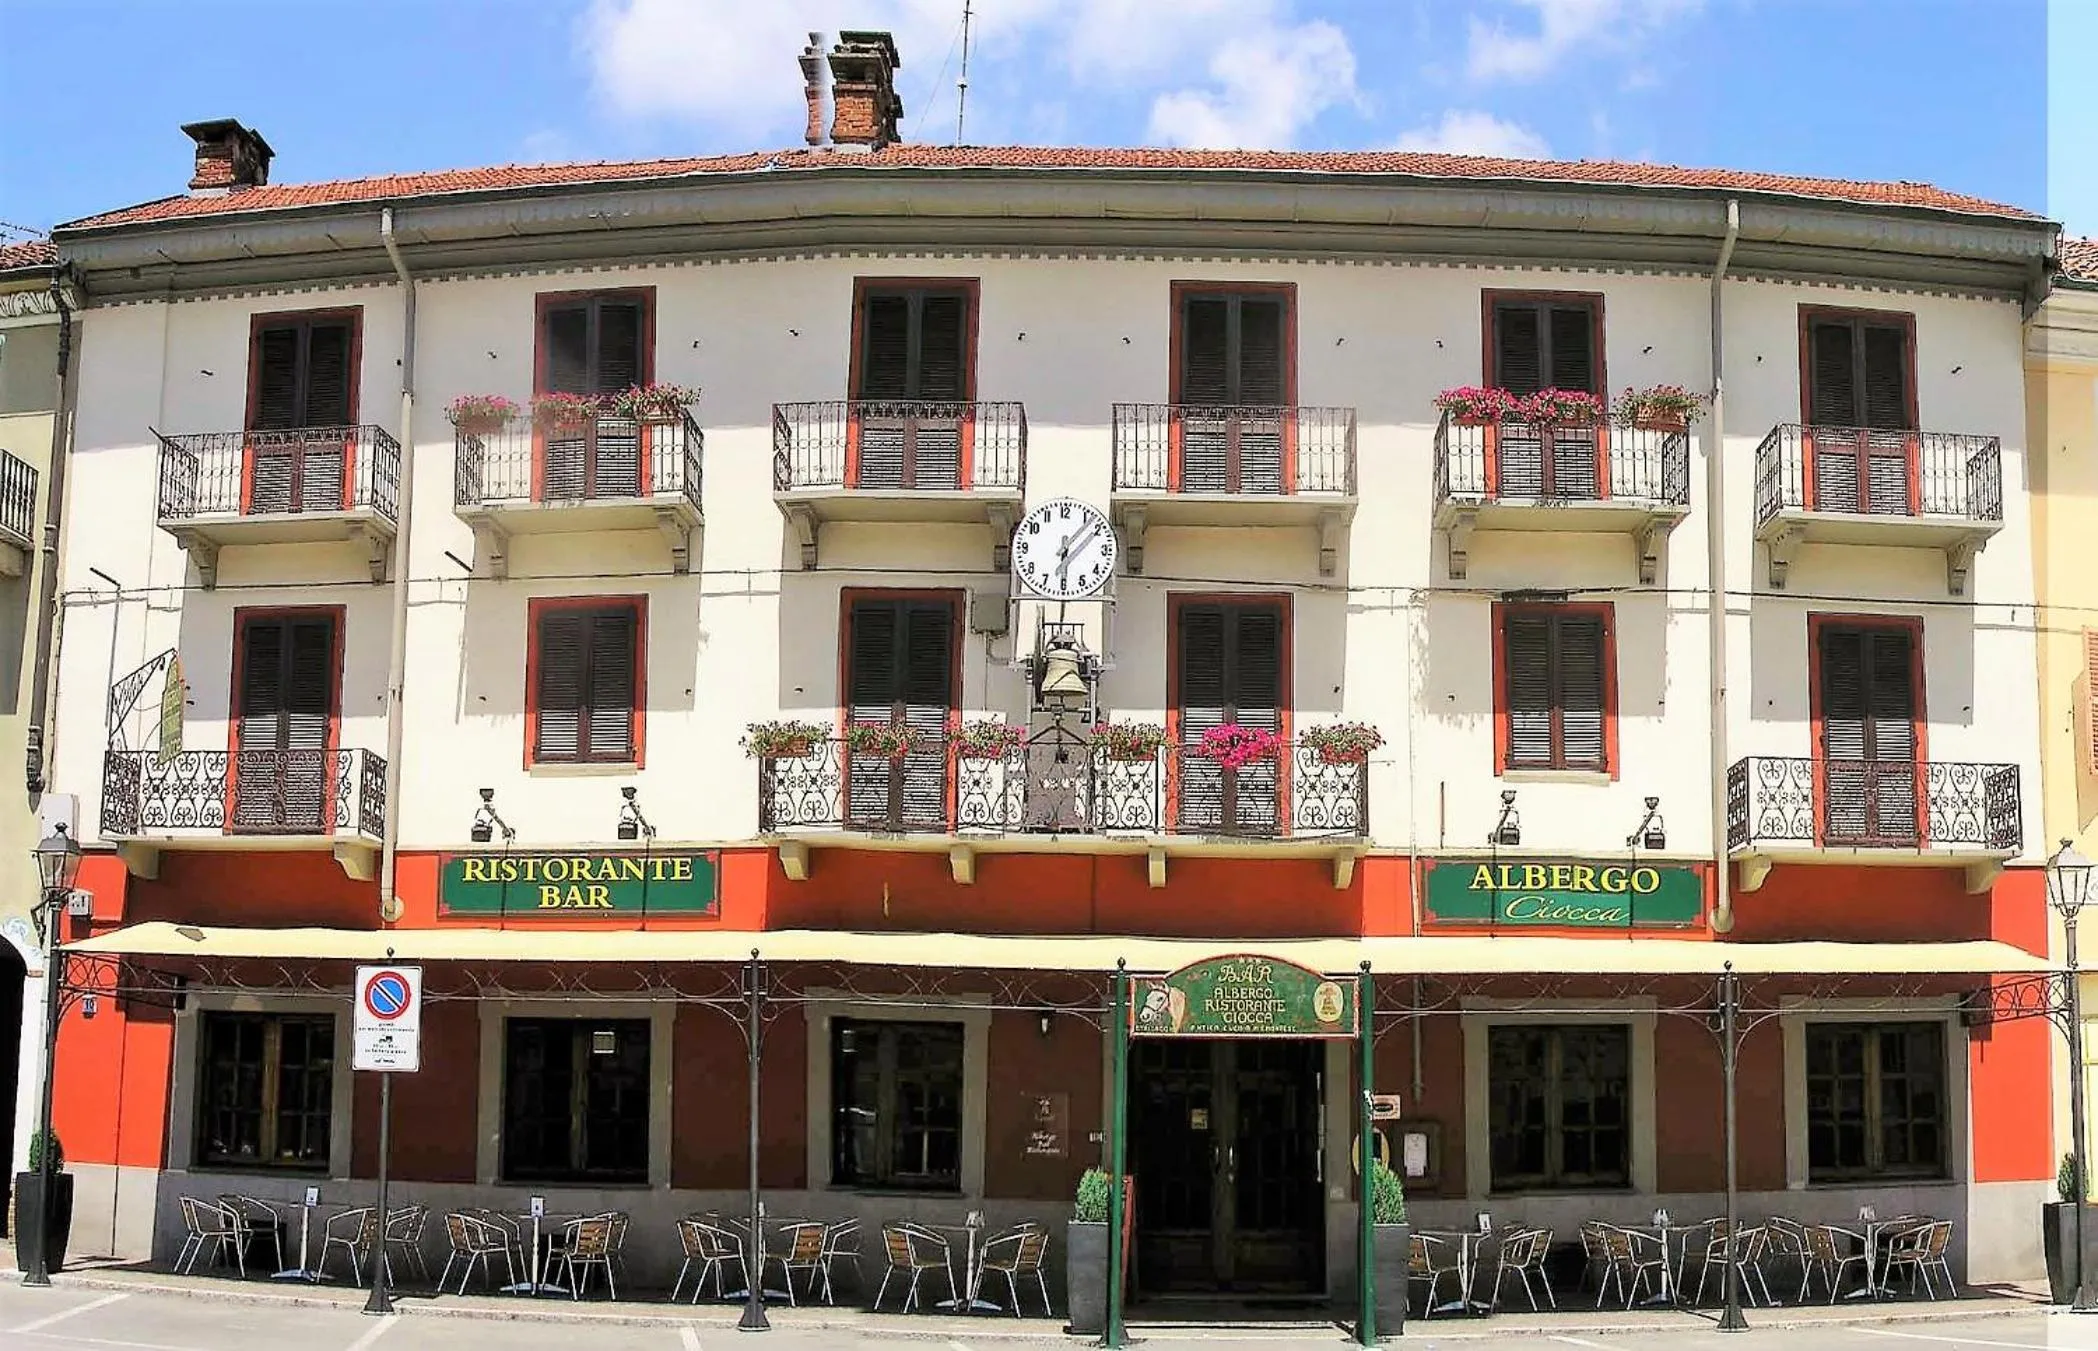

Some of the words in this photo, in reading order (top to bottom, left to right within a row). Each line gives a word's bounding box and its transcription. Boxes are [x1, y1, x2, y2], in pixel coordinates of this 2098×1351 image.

[1044, 510, 1051, 523] 11
[1060, 506, 1071, 519] 12
[1029, 521, 1040, 535] 10
[1094, 523, 1101, 537] 2
[1021, 542, 1029, 554] 9
[1101, 543, 1108, 556] 3
[1027, 561, 1035, 574] 8
[1092, 562, 1099, 575] 4
[1042, 573, 1049, 586] 7
[1060, 578, 1067, 591] 6
[1078, 574, 1086, 587] 5
[462, 857, 694, 882] RISTORANTE
[1468, 864, 1661, 893] ALBERGO
[538, 885, 613, 910] BAR
[1504, 895, 1631, 922] Ciocca
[1217, 964, 1274, 984] BAR
[1214, 986, 1273, 999] ALBERGO
[1205, 999, 1286, 1012] RISTORANTE
[1223, 1011, 1273, 1024] CIOCCA
